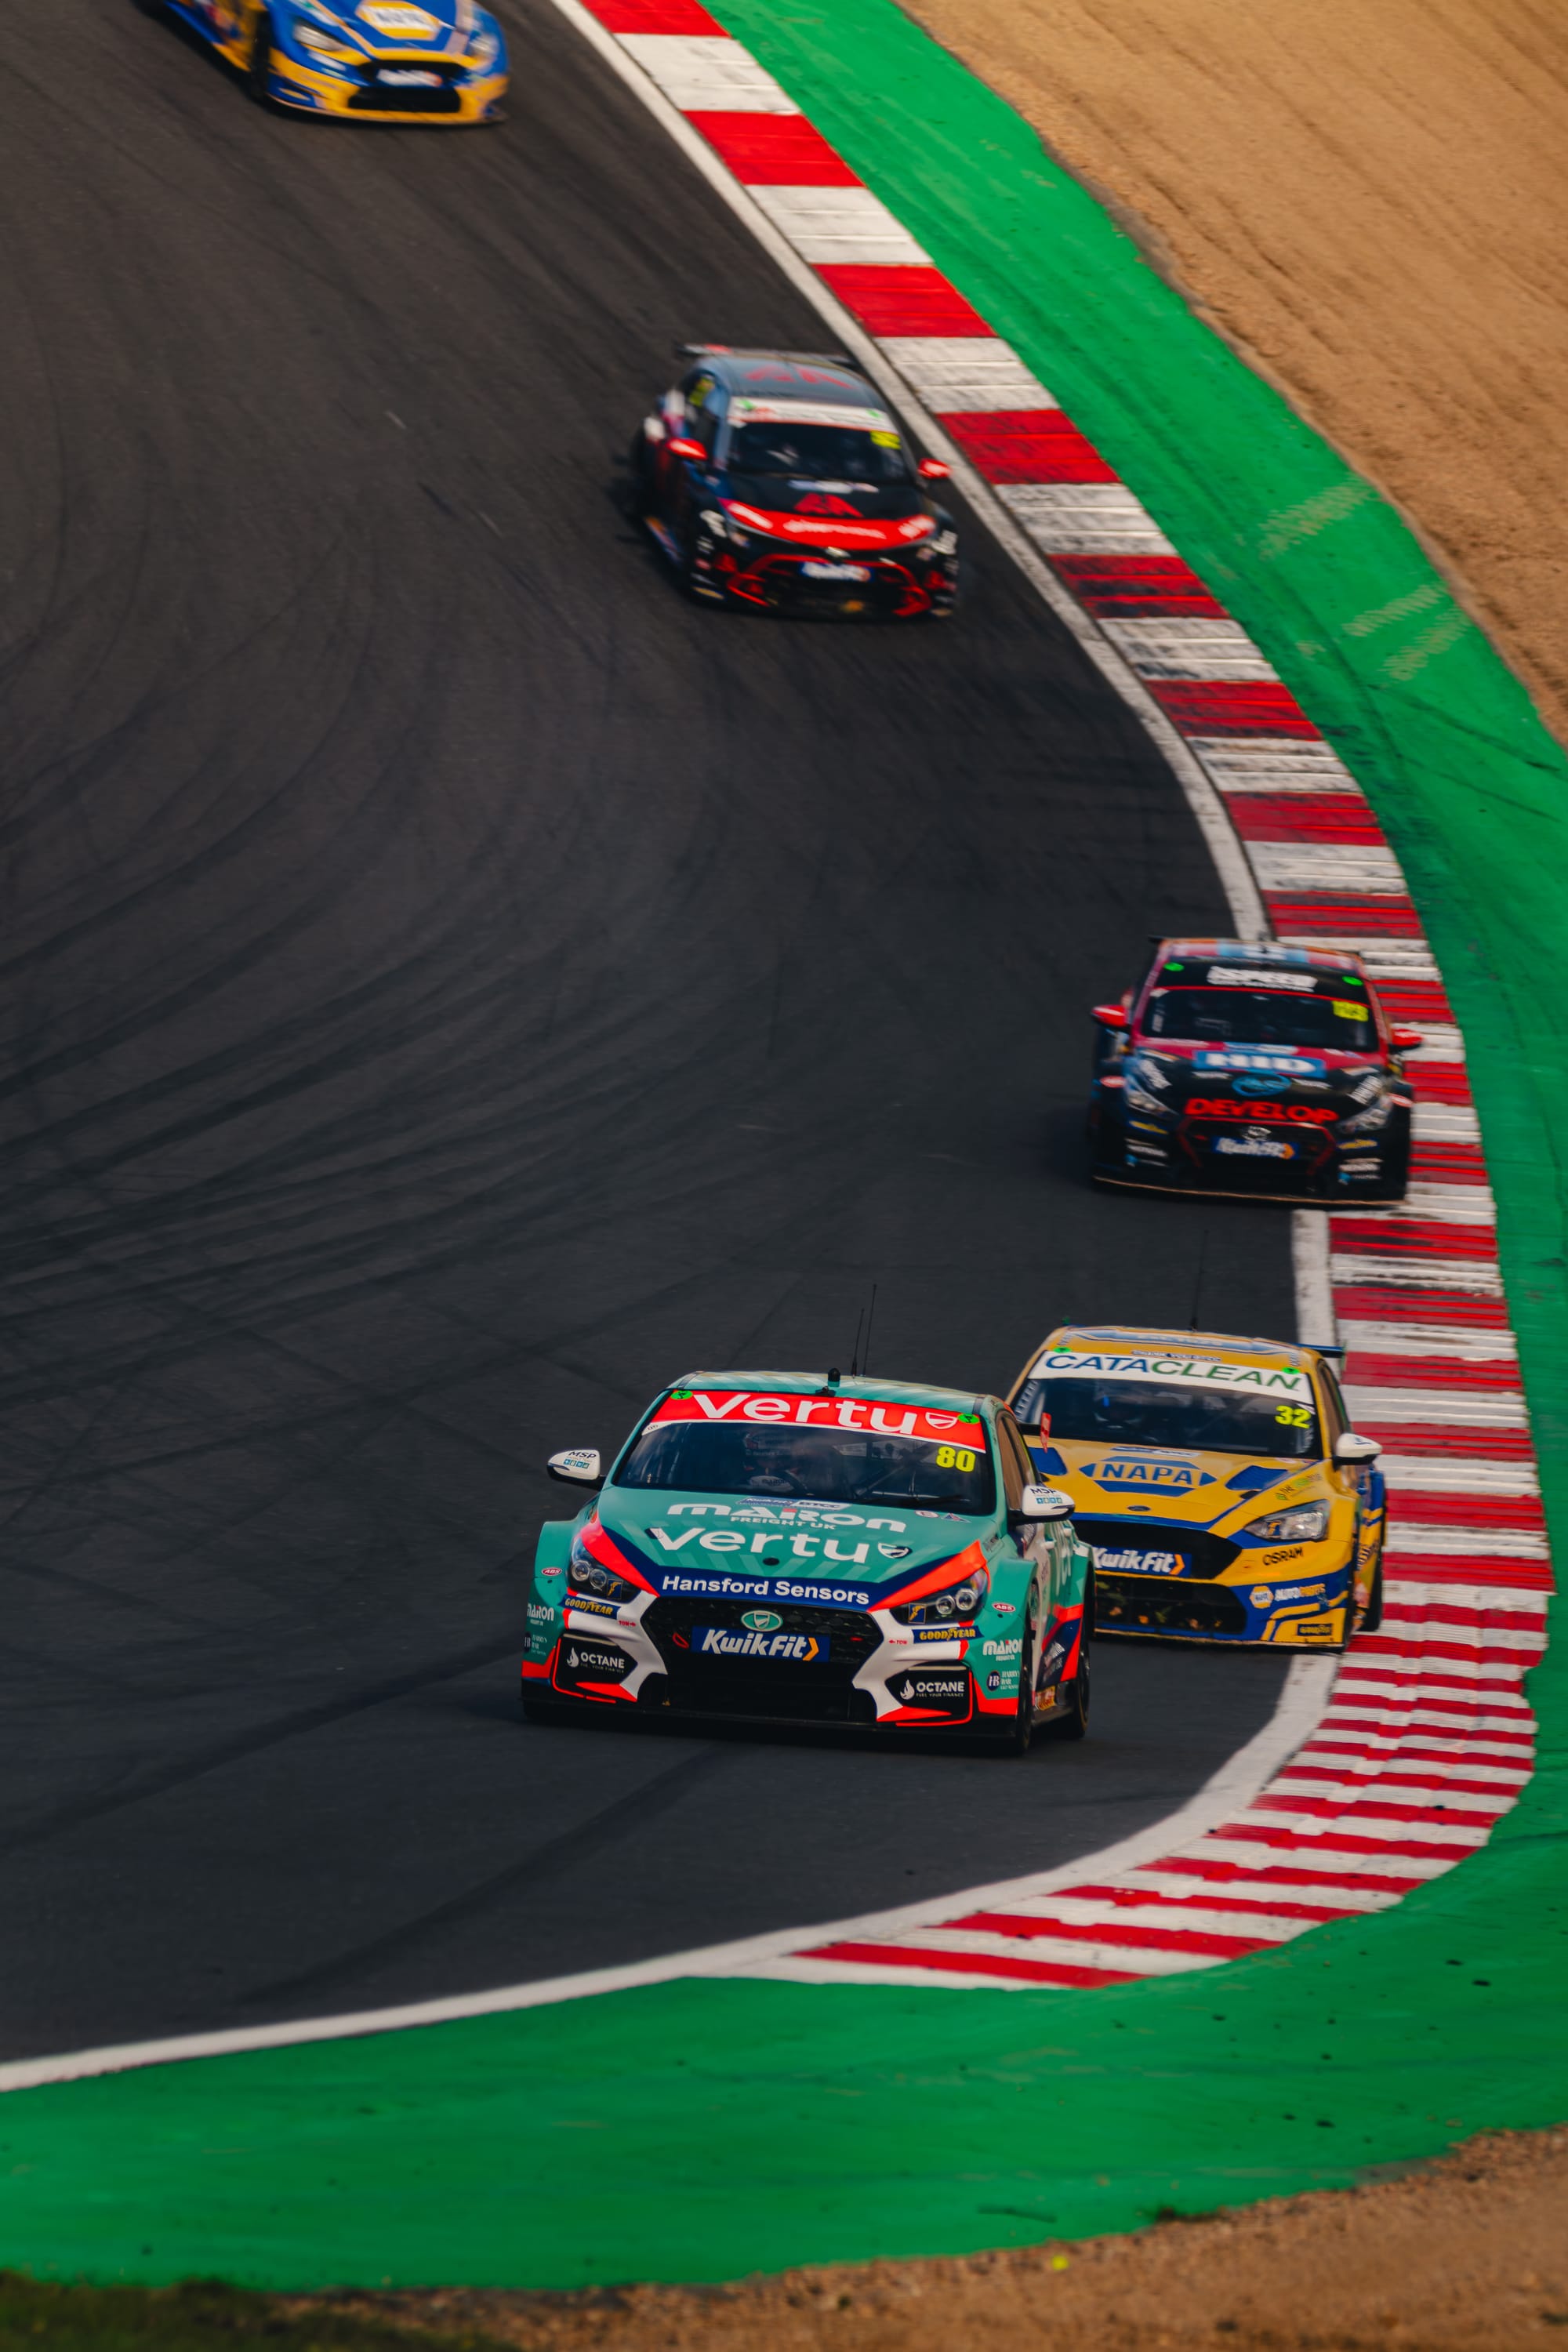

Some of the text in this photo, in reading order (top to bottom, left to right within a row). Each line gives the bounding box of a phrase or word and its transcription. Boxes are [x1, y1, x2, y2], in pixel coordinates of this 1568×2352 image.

[1184, 1098, 1340, 1124] DEVELOP
[1045, 1355, 1301, 1391] CATACLEAN
[1274, 1405, 1312, 1429] 32
[935, 1446, 976, 1472] 80
[1102, 1463, 1192, 1486] NAPA
[731, 1516, 806, 1526] FREIGHT
[1263, 1547, 1303, 1566] OSRAM
[662, 1575, 869, 1605] Hansford Sensors
[564, 1598, 614, 1615] GOODYEAR
[920, 1628, 976, 1642] GOODYEAR
[580, 1651, 625, 1669] OCTANE
[916, 1682, 965, 1693] OCTANE
